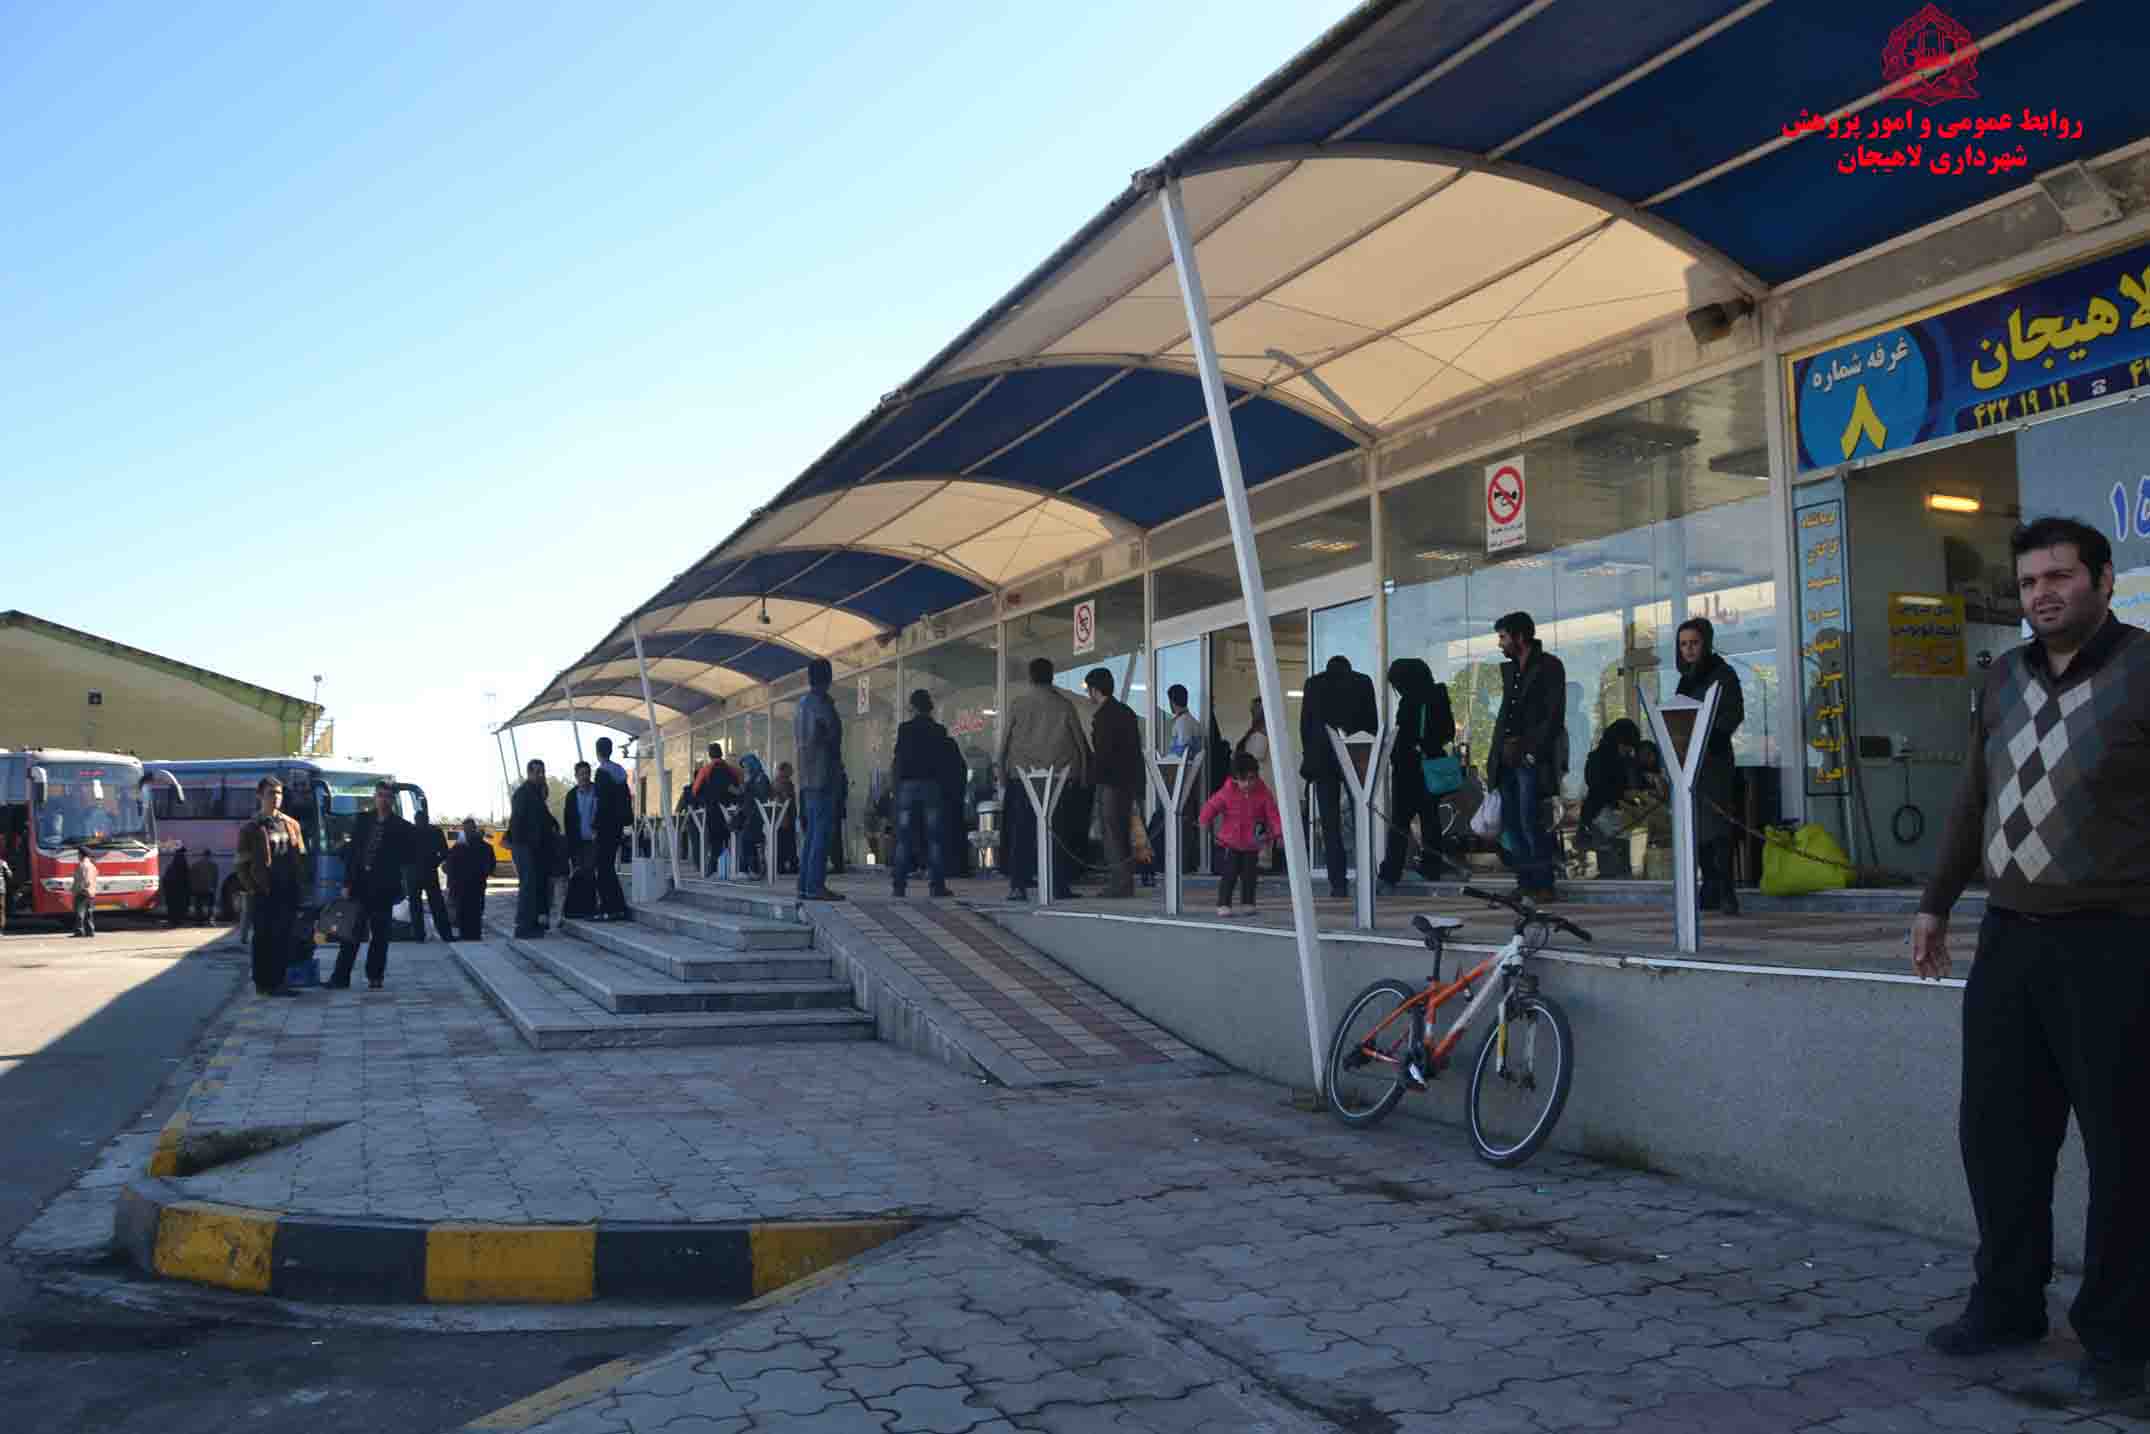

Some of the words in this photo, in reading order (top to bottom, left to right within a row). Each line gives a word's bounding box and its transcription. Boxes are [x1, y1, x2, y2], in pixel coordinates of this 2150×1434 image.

[1812, 352, 1862, 392] شماره
[1867, 336, 1910, 373] غرفه
[1840, 384, 1888, 460] ۸
